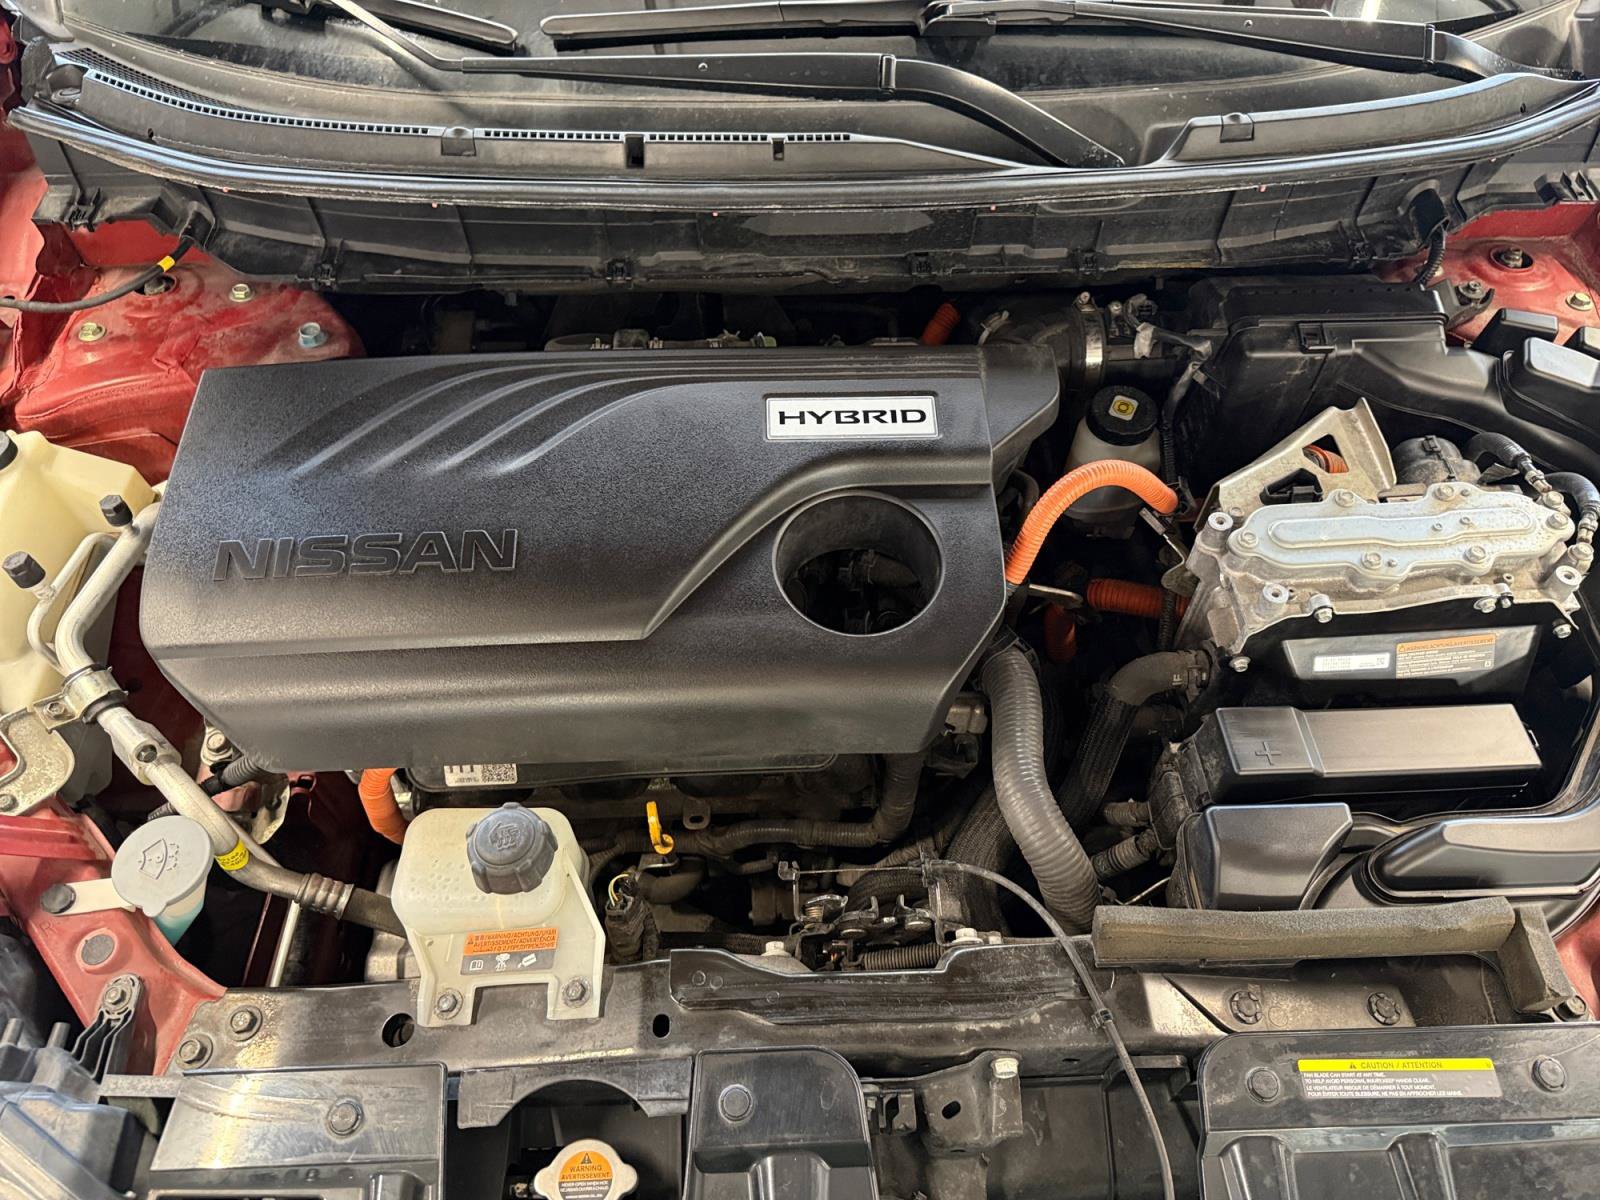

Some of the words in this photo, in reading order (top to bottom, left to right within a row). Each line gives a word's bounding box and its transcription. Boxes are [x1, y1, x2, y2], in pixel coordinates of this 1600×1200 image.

[779, 410, 926, 424] HYBRID
[213, 529, 518, 581] NISSAN
[1402, 1061, 1442, 1069] ATTENTION
[570, 1165, 602, 1173] WARNING
[561, 1172, 610, 1180] AVERTISSEMENT
